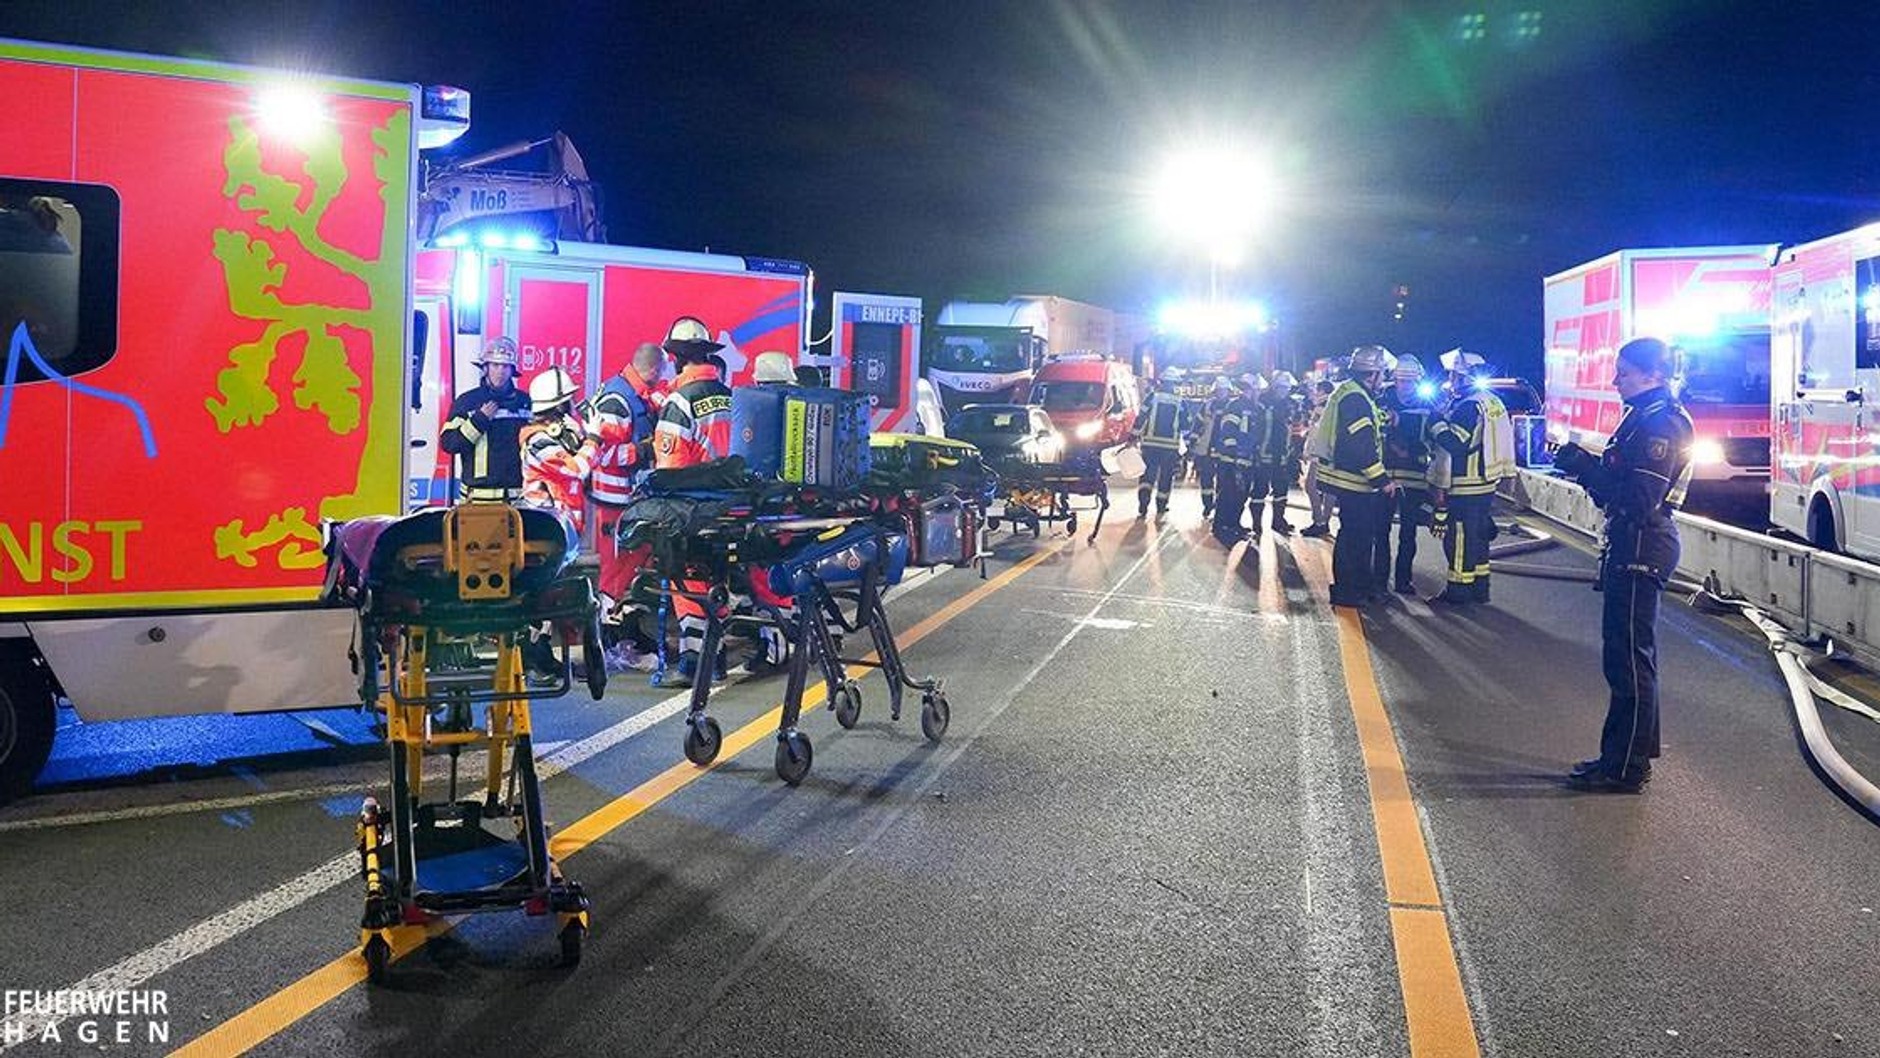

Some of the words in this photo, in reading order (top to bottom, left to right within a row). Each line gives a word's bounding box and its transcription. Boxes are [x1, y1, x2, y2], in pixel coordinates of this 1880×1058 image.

[470, 189, 507, 211] Moß
[547, 346, 582, 374] 112
[960, 381, 993, 390] IVECO
